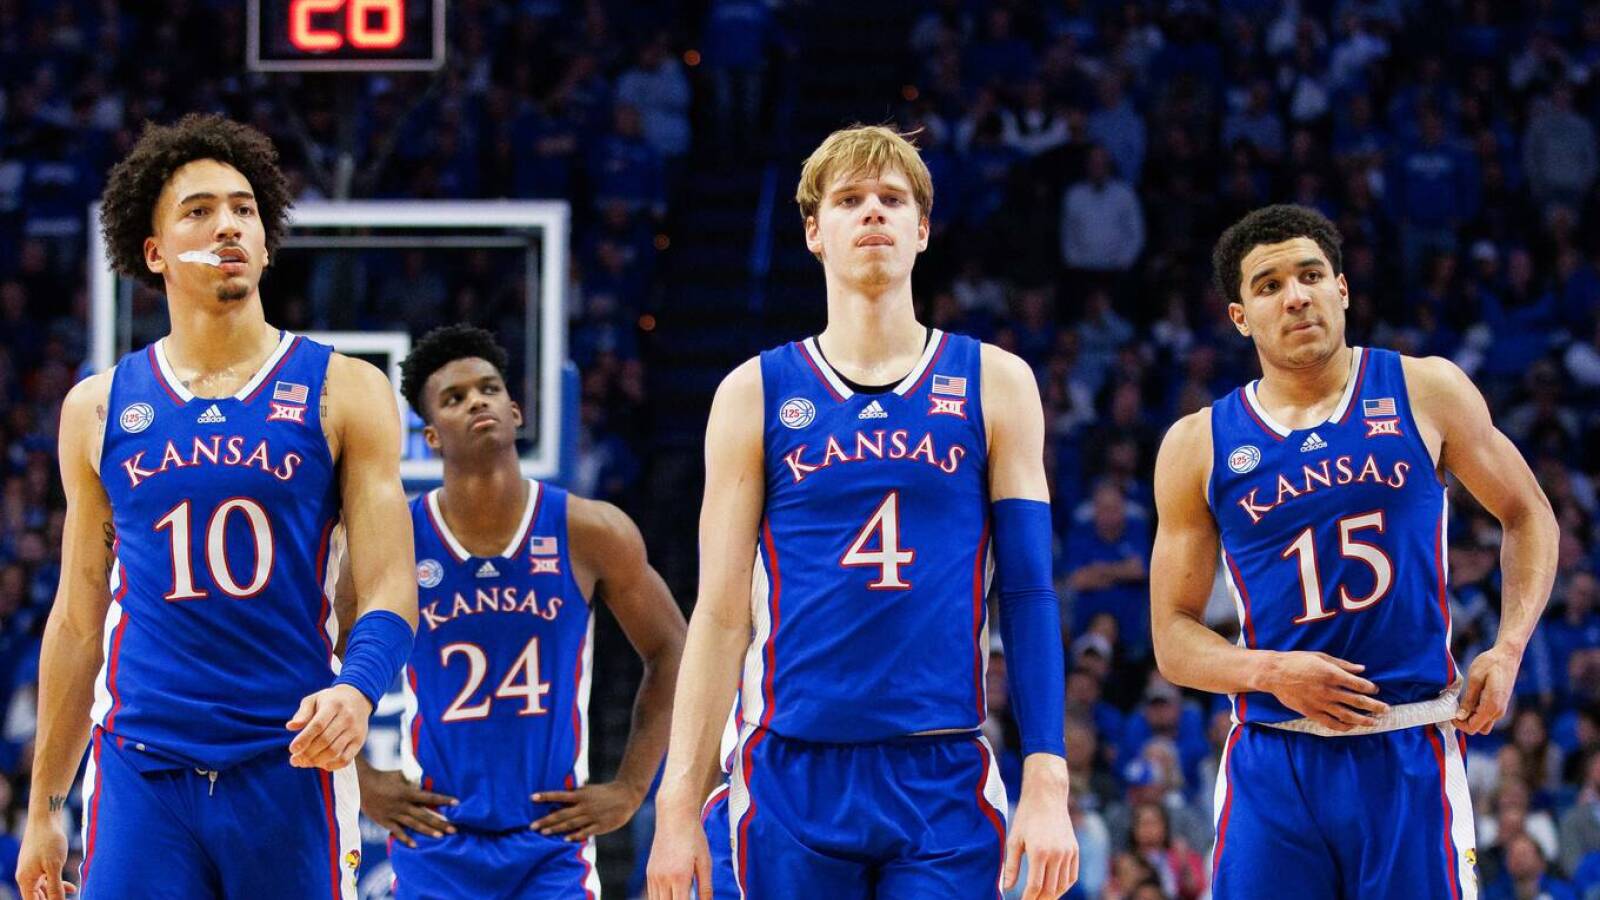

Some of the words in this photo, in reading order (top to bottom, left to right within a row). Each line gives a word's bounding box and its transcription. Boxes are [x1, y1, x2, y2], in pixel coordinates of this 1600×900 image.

[124, 413, 140, 423] 125
[784, 409, 800, 419] 125
[122, 435, 301, 488] KANSAS
[784, 429, 965, 484] KANSAS
[1233, 456, 1247, 466] 125
[1238, 453, 1410, 524] KANSAS
[154, 496, 275, 601] 10
[839, 489, 915, 591] 4
[1281, 509, 1394, 624] 15
[420, 586, 563, 631] KANSAS
[440, 635, 551, 723] 24
